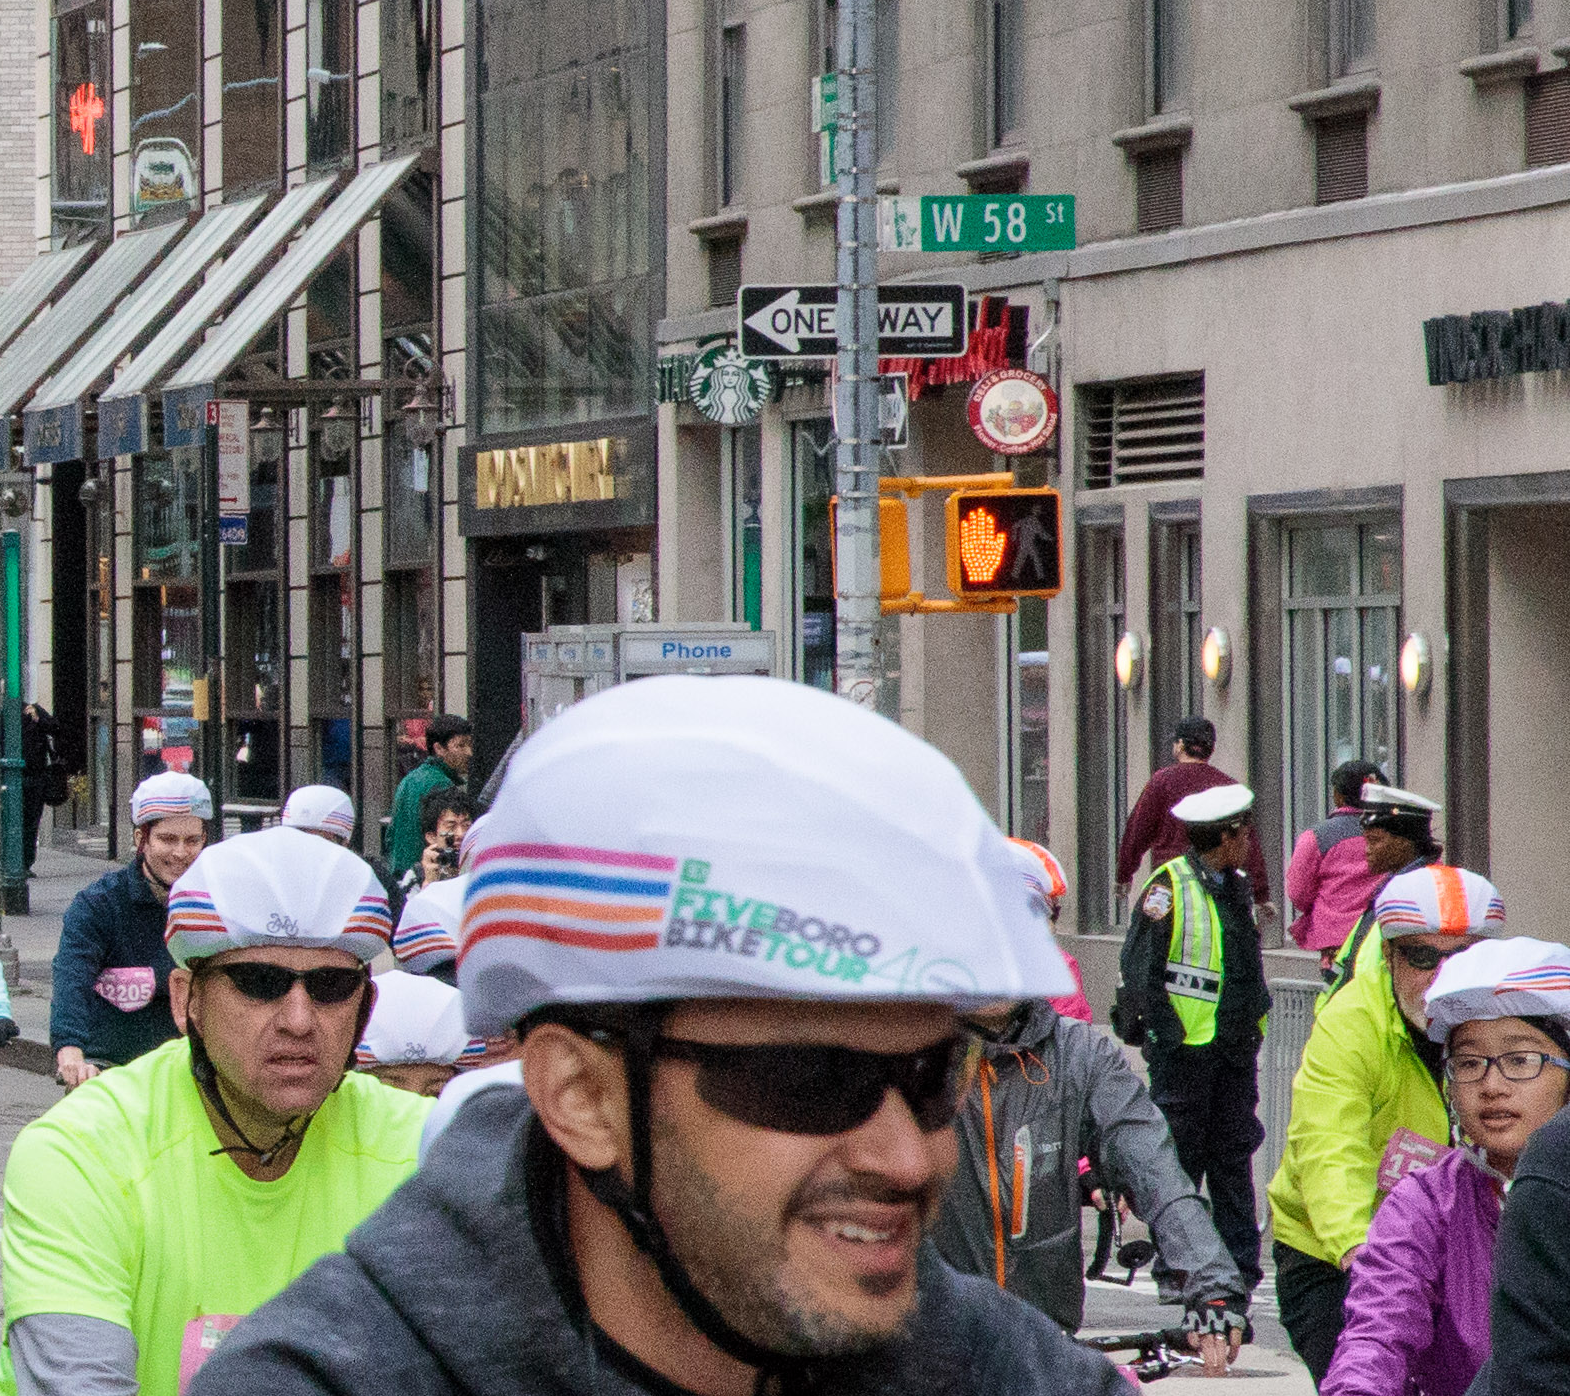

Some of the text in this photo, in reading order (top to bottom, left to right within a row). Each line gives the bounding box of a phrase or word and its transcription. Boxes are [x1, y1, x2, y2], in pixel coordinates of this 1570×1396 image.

[932, 200, 1066, 245] W 58 St
[772, 307, 945, 336] ONE WAY
[661, 641, 733, 659] Phone
